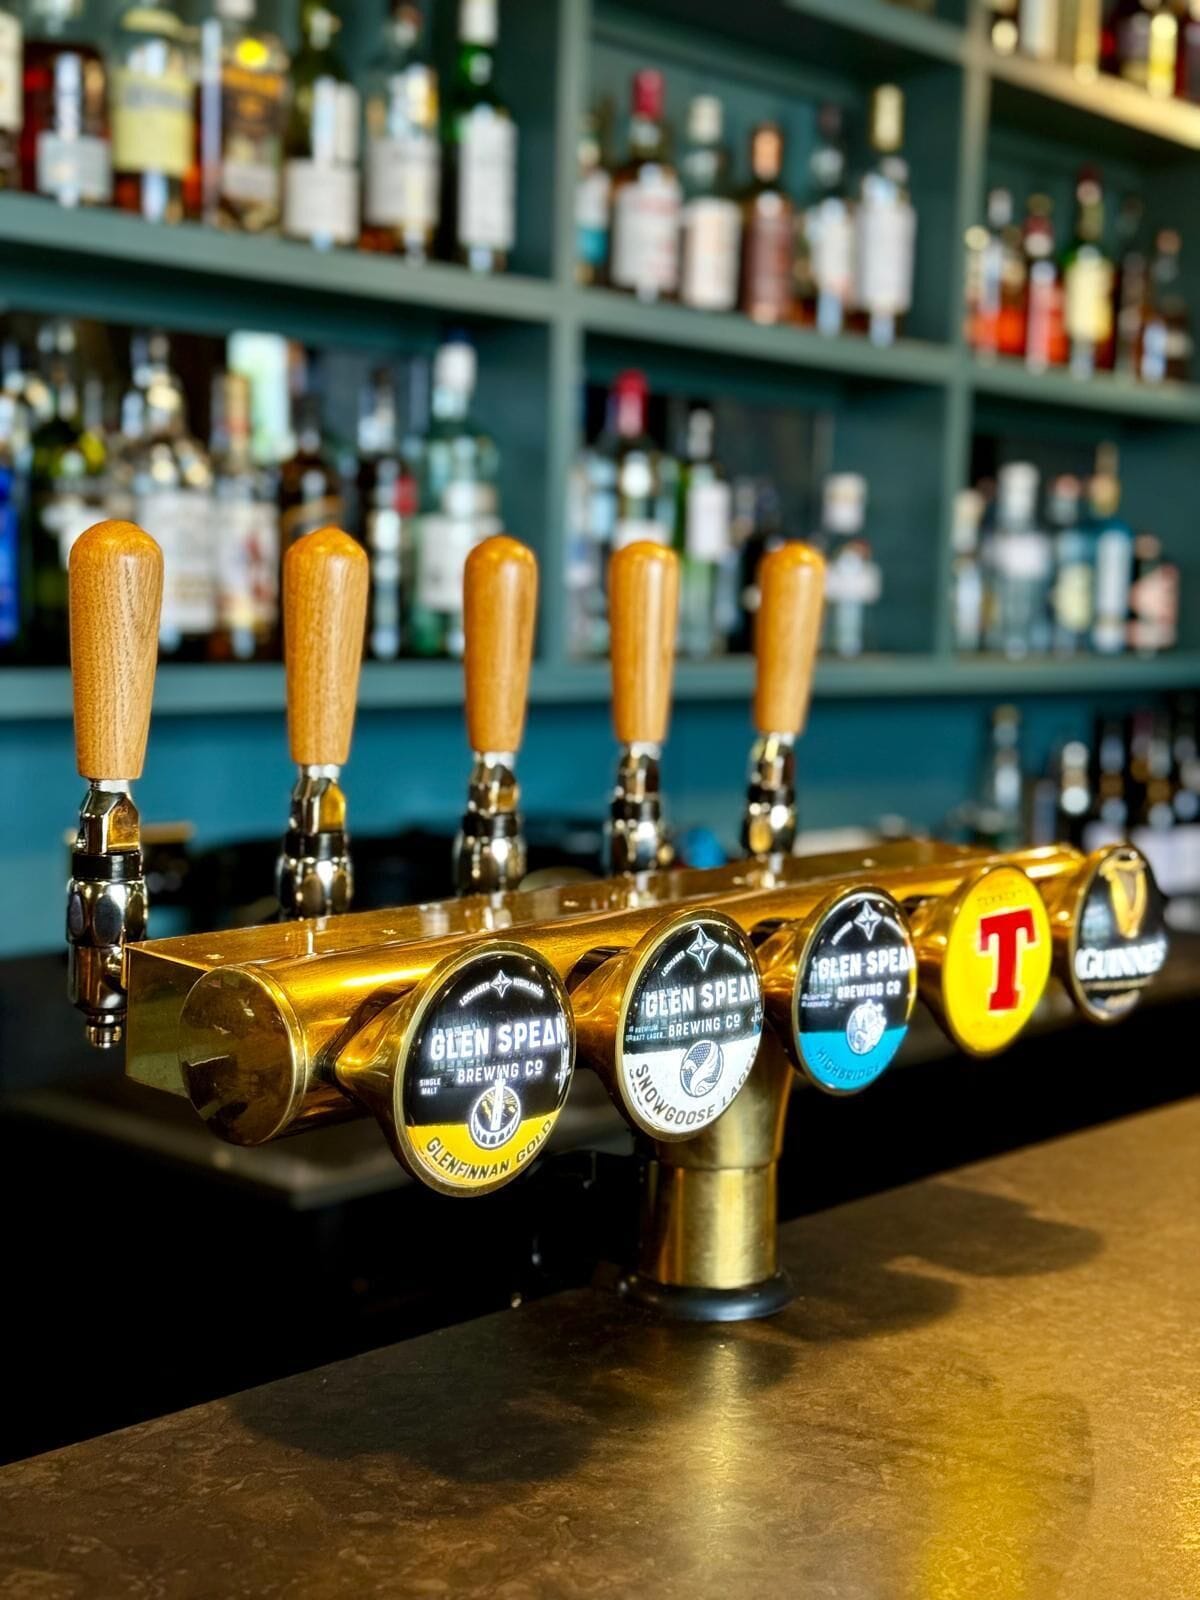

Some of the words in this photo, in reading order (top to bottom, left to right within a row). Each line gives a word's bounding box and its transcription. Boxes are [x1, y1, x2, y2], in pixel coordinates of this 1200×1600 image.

[819, 953, 862, 980] GLEN
[980, 909, 1036, 1011] T
[645, 986, 694, 1018] GLEN
[700, 973, 759, 1008] SPEAN
[837, 982, 884, 1000] BREWING
[430, 1027, 489, 1061] GLEN
[498, 1016, 567, 1053] SPEAN
[668, 1016, 720, 1038] BREWING
[419, 1077, 441, 1087] SINGLE
[457, 1060, 519, 1084] BREWING
[421, 1086, 437, 1096] MALT
[635, 1063, 716, 1126] SNOWGOOSE
[426, 1136, 510, 1180] GLENFINNAN
[516, 1119, 552, 1164] GOLD
